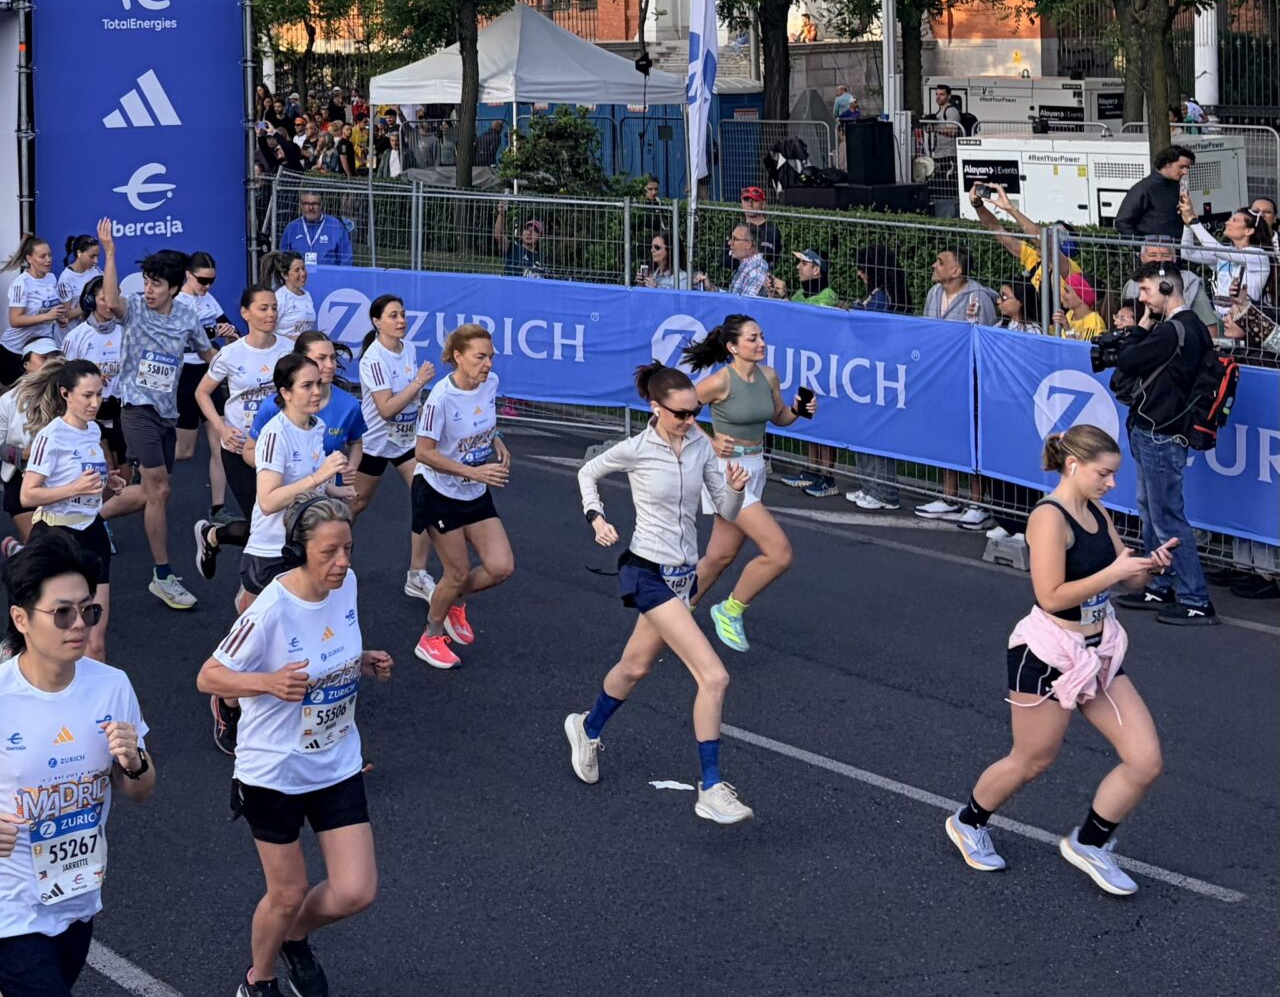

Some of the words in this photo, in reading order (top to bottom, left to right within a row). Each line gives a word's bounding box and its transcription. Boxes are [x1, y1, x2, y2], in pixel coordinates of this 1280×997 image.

[102, 18, 177, 31] TotalEnergies
[1028, 154, 1080, 163] #RentYourPower
[998, 167, 1018, 175] Events
[111, 215, 183, 237] bercaja
[147, 363, 169, 377] 55810
[768, 345, 907, 409] URICH
[328, 685, 356, 700] ZURICH
[316, 703, 347, 726] 55506
[60, 754, 85, 764] ZURICH
[22, 775, 112, 820] MADRID
[61, 812, 98, 830] ZURIC
[49, 833, 98, 864] 55267
[62, 857, 89, 872] JARRETTE
